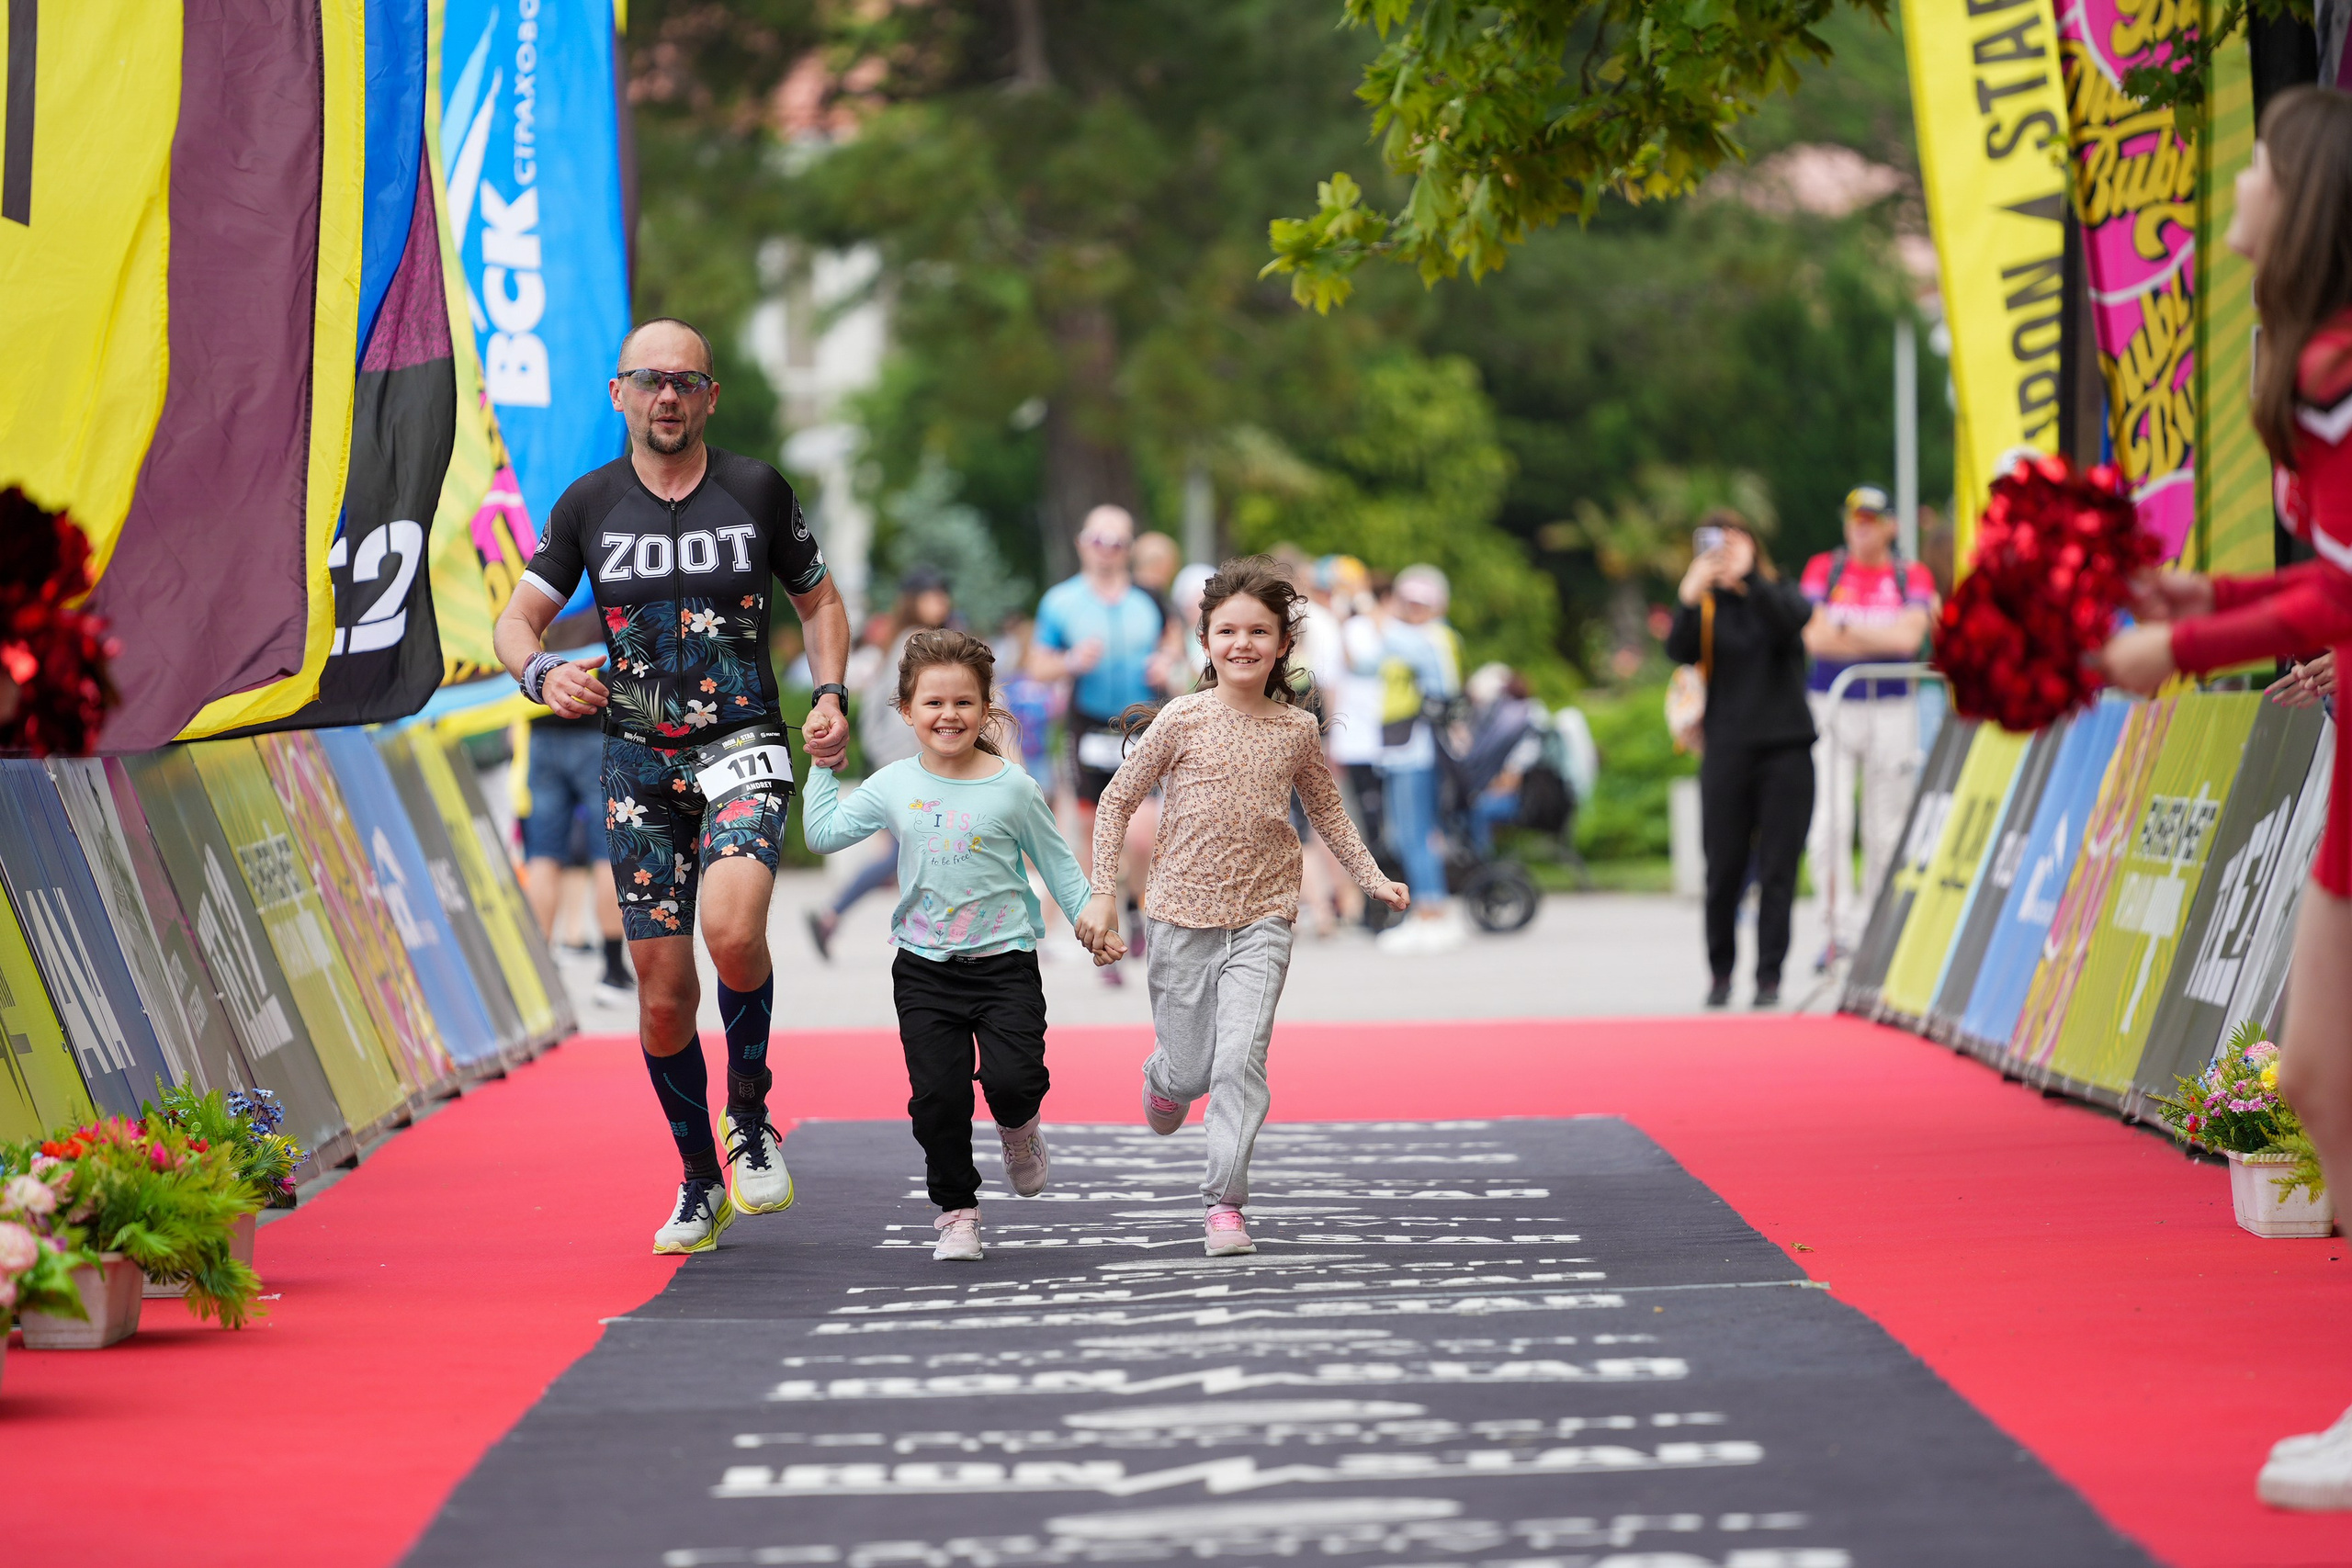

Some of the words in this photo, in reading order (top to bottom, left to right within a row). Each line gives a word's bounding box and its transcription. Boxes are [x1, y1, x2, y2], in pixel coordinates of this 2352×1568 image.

[480, 176, 551, 408] ВСК
[599, 524, 756, 582] ZOOT
[722, 738, 736, 749] IRON
[740, 732, 755, 741] STAR
[728, 751, 773, 779] 171
[745, 781, 772, 791] ANDREY
[931, 857, 939, 865] to
[942, 856, 951, 865] be
[953, 849, 973, 865] free!
[1295, 1234, 1582, 1243] STAR
